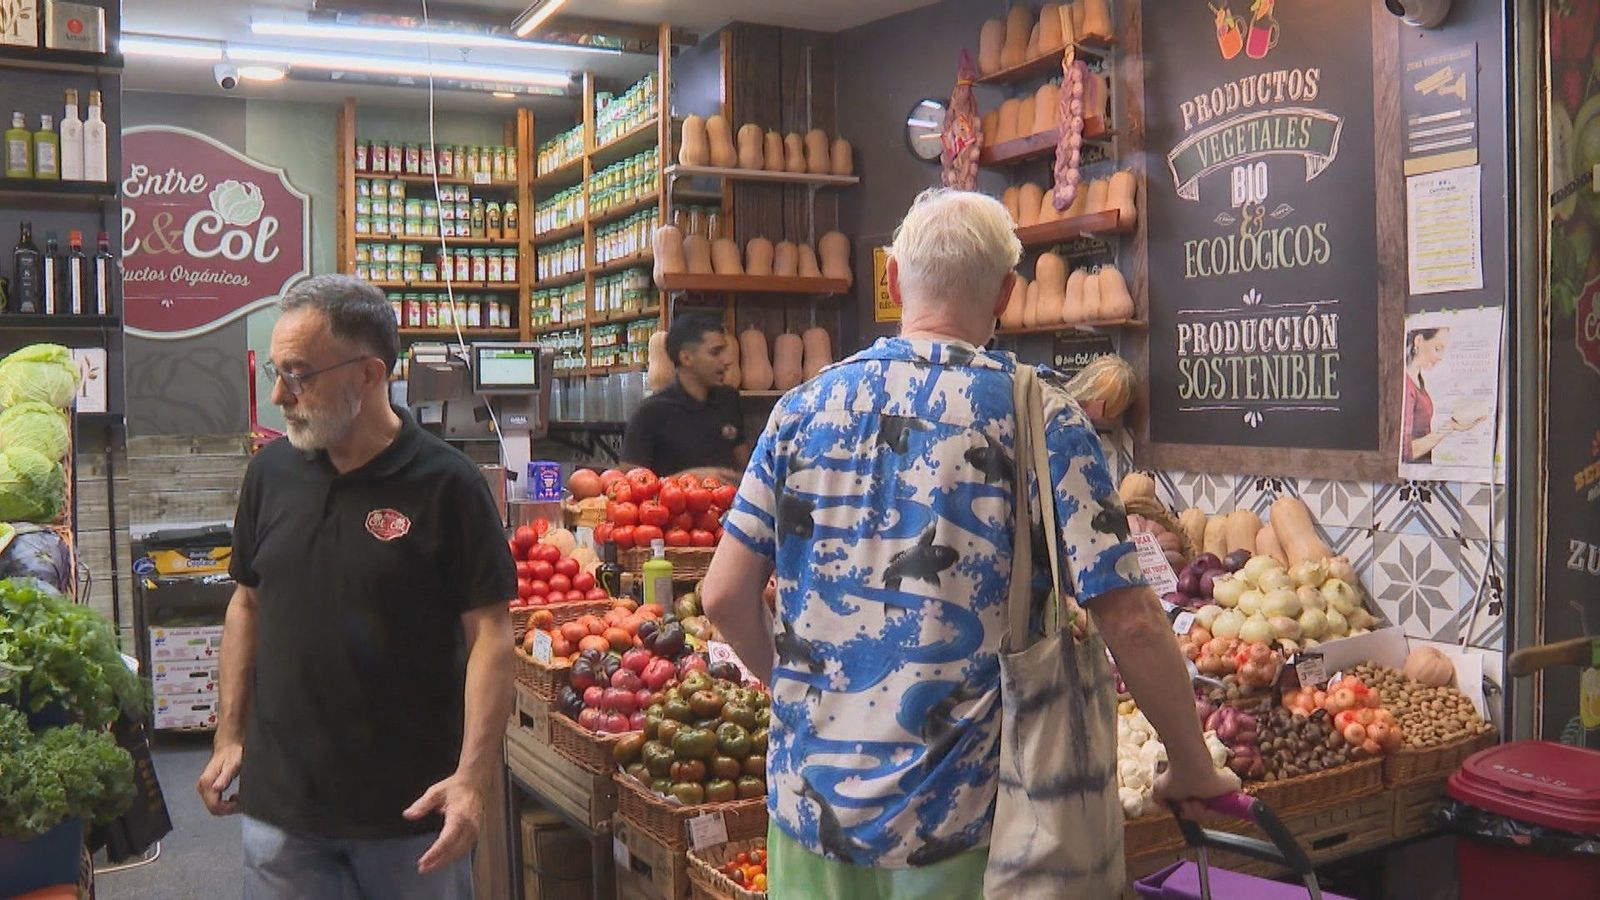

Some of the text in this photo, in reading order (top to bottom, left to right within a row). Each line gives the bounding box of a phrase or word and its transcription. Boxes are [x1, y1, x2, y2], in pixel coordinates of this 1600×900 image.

[1180, 68, 1321, 131] PRODUCTOS
[1196, 116, 1313, 168] VEGETALES
[122, 163, 208, 198] Entre
[1231, 161, 1269, 208] BIO
[142, 211, 184, 255] &
[183, 209, 280, 264] Col
[170, 264, 250, 287] Orgánicos
[1177, 304, 1339, 356] PRODUCCIÓN
[1178, 352, 1340, 400] SOSTENIBLE
